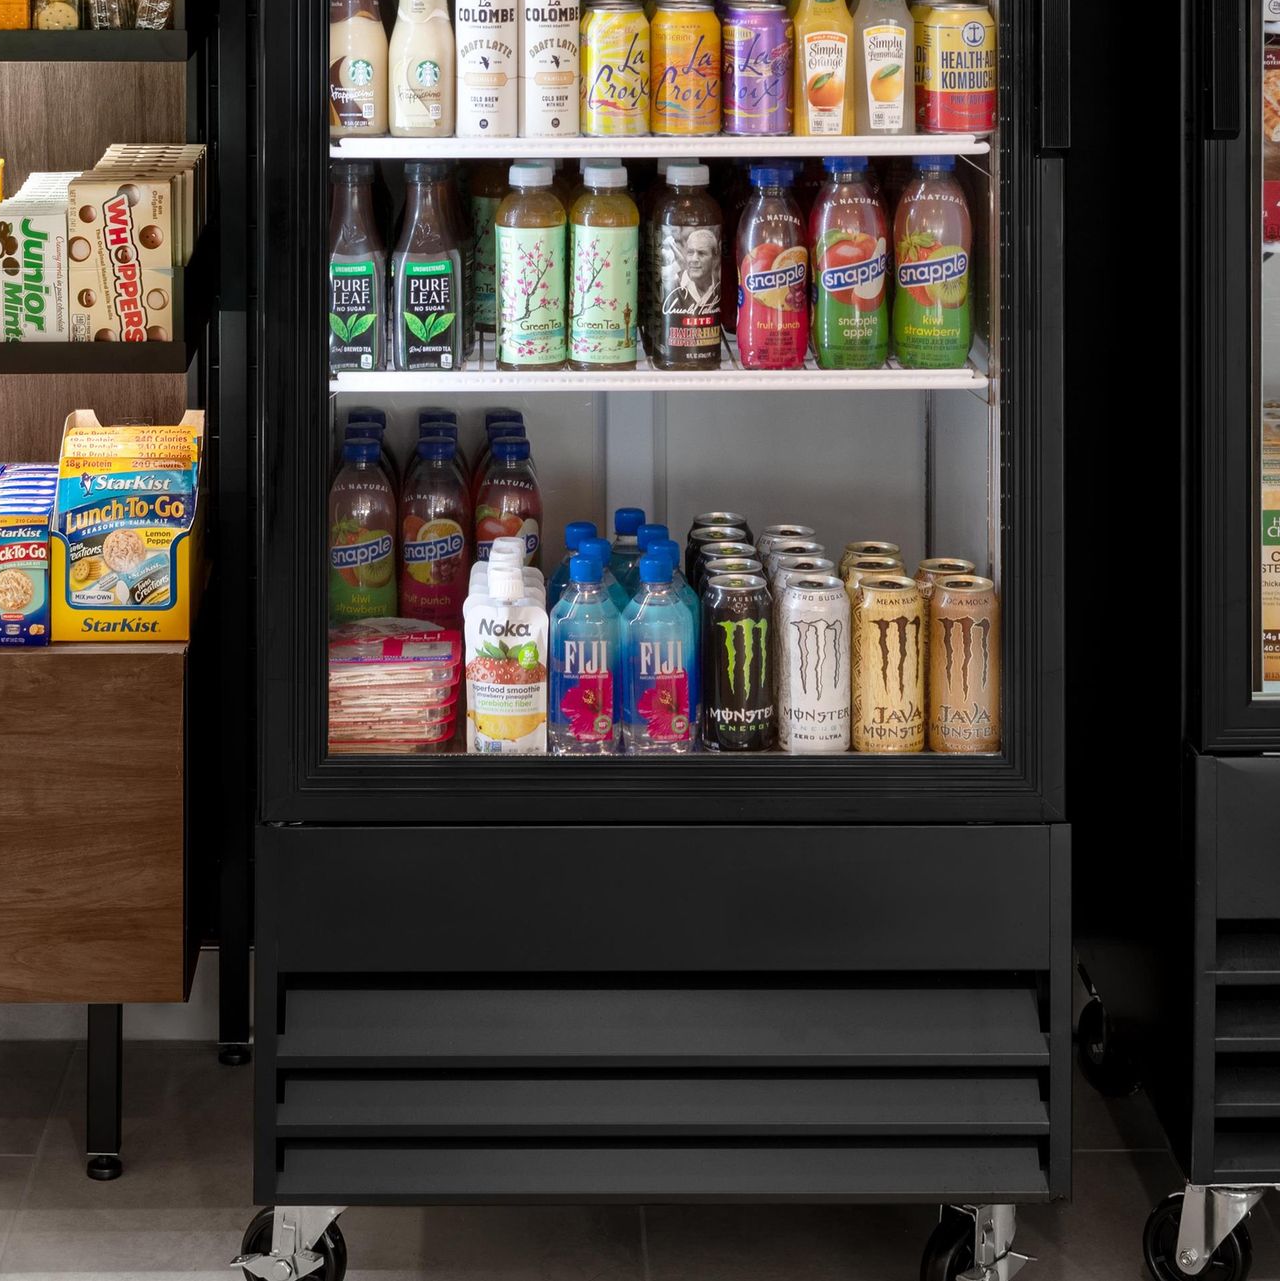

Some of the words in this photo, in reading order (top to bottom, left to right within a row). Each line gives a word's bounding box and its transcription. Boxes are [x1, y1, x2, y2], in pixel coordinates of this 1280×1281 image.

[459, 7, 515, 23] COLOMBE
[809, 43, 843, 57] Simply
[19, 218, 48, 332] Junior
[411, 278, 449, 291] PURE
[686, 317, 711, 325] LITE
[777, 321, 801, 331] punch
[838, 316, 878, 327] snapple
[843, 326, 873, 338] apple
[904, 324, 961, 336] strawberry
[65, 460, 80, 469] 18g
[81, 617, 160, 633] StarKist
[479, 619, 530, 636] Noka
[640, 641, 683, 674] FIJI
[507, 686, 540, 694] smoothie
[872, 701, 921, 724] JAVA
[719, 722, 770, 732] ENERGY
